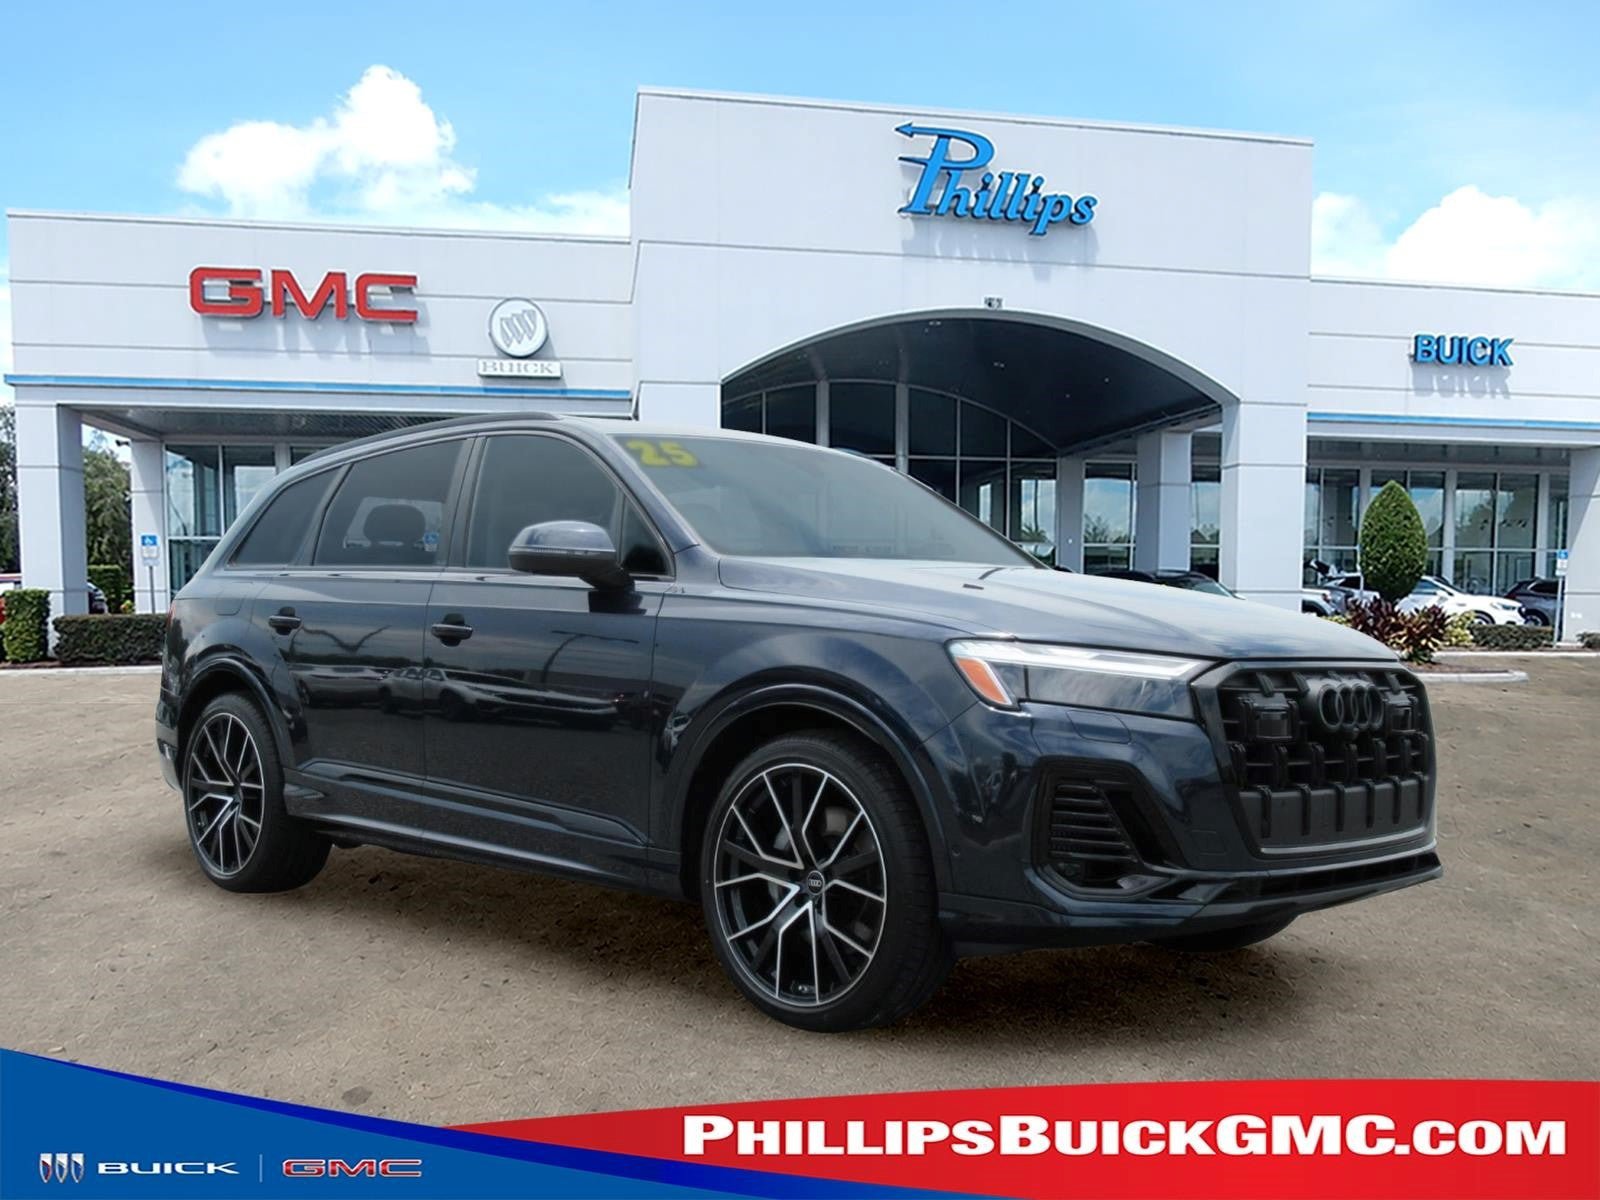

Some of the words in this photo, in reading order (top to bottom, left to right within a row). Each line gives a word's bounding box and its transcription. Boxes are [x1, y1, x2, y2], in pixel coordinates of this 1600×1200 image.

[896, 122, 1097, 236] Phillips
[190, 267, 418, 324] GMC
[1414, 334, 1513, 366] BUICK
[482, 361, 553, 374] BUICK
[625, 439, 698, 468] 25
